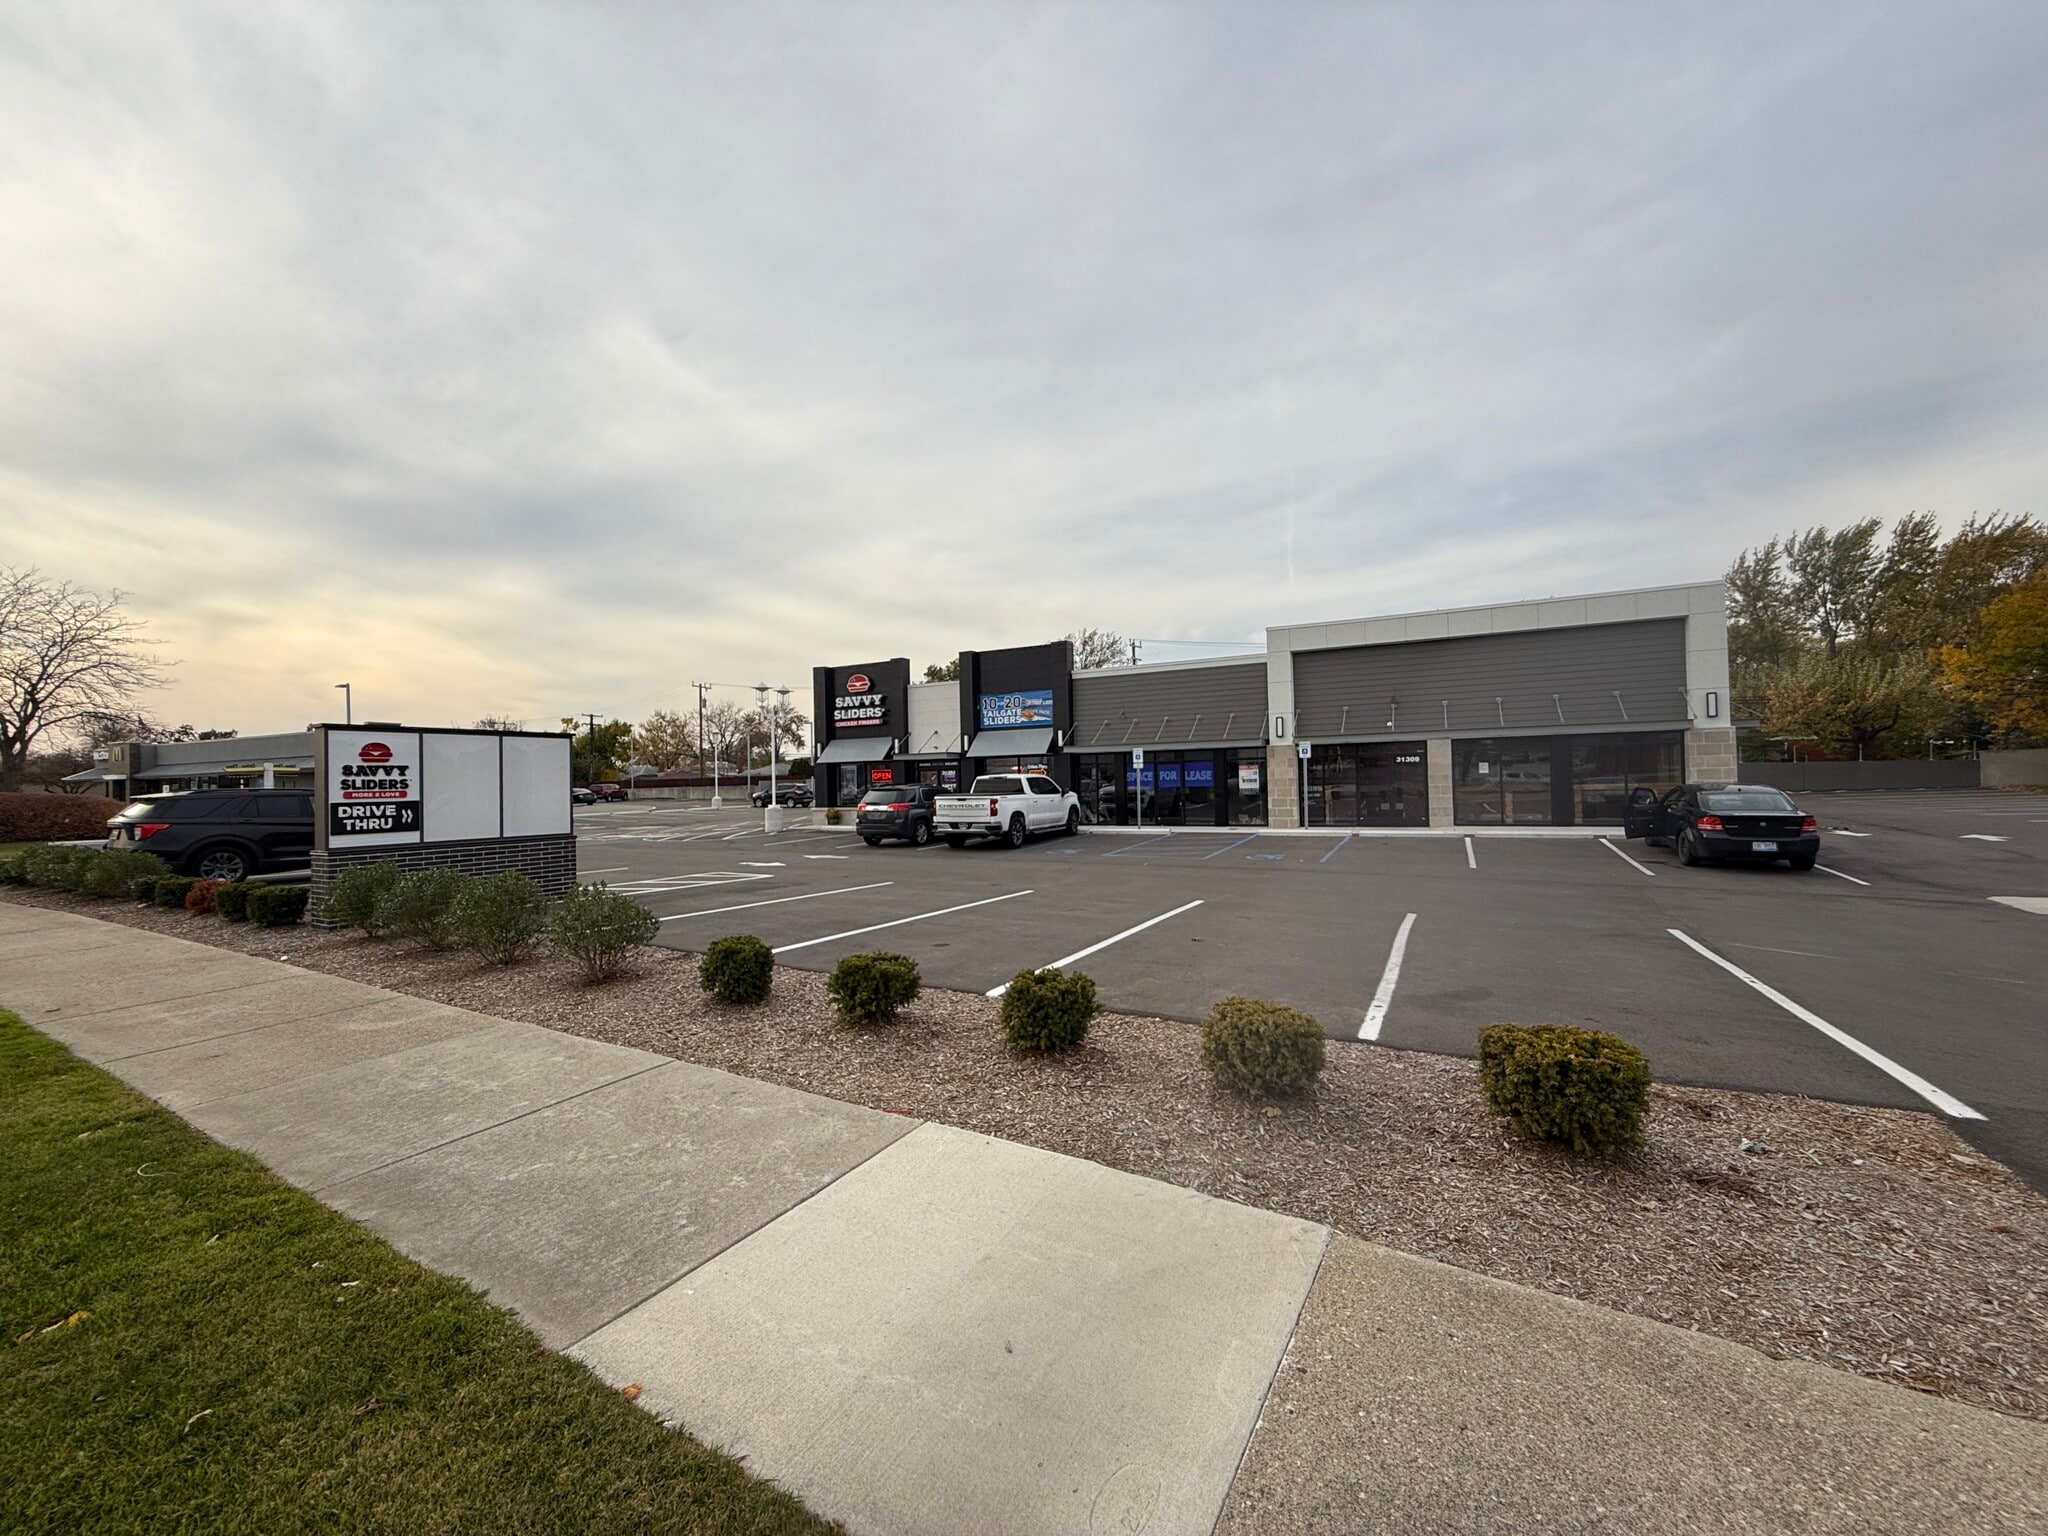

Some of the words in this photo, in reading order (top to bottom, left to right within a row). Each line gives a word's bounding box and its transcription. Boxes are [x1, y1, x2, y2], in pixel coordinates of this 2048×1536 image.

[835, 694, 882, 708] SAVVY
[983, 697, 997, 710] 10
[1004, 695, 1021, 709] 20
[834, 707, 883, 720] SLIDERS
[983, 709, 1022, 717] TAILGATE
[983, 716, 1022, 725] SLIDERS
[342, 765, 409, 777] SAVVY
[872, 772, 891, 780] OPEN
[1160, 771, 1177, 780] FOR
[1185, 770, 1212, 780] LEASE
[340, 778, 409, 790] SLIDERS
[338, 804, 396, 818] DRIVE
[342, 818, 393, 831] THRU
